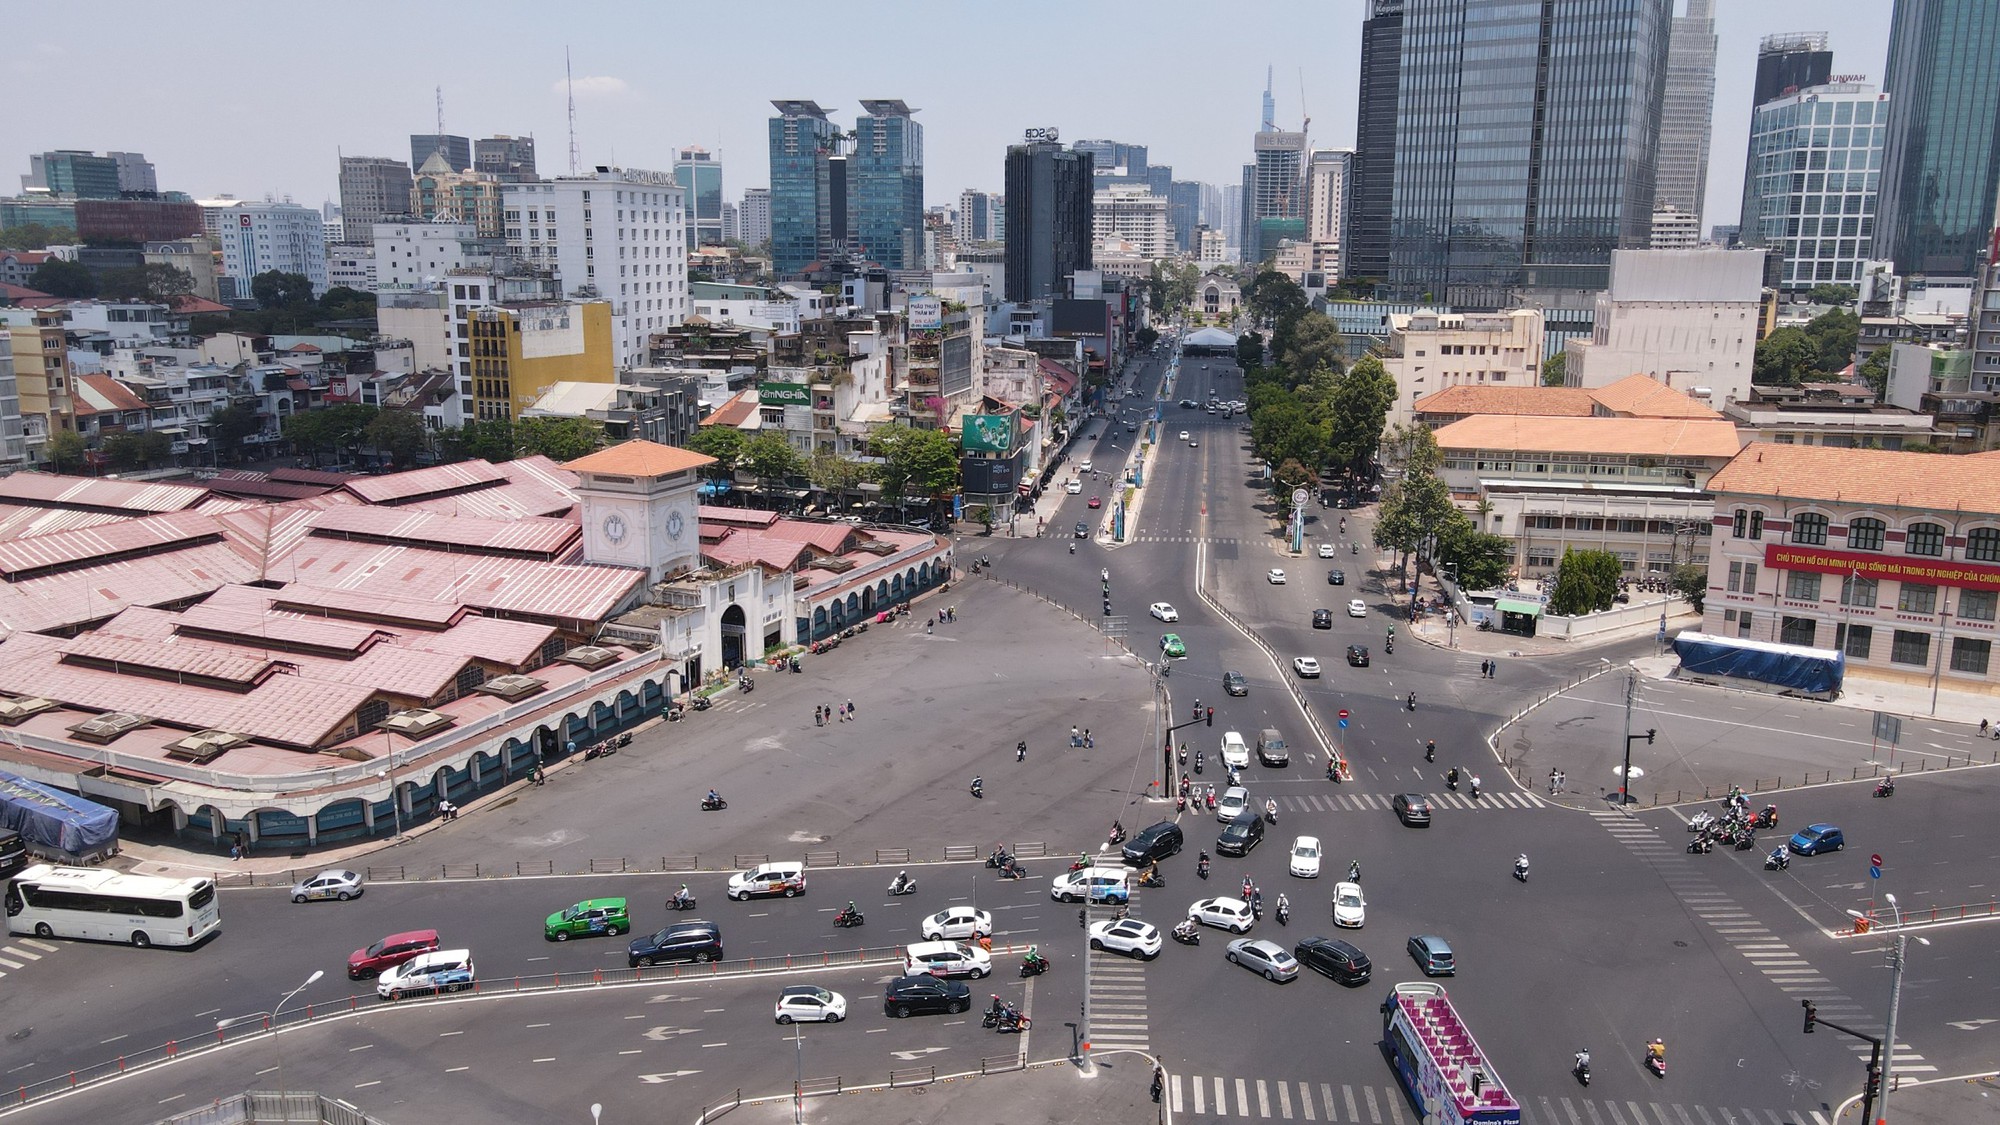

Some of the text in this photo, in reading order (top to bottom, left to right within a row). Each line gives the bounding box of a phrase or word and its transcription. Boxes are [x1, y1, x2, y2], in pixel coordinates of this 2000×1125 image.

[1376, 4, 1403, 12] Keppel
[1264, 137, 1298, 145] THE NEXUS
[1776, 552, 1790, 562] CHỦ
[1791, 554, 1806, 565] TỊCH
[1806, 554, 1816, 565] HỒ
[1817, 556, 1828, 566] CHÍ
[1829, 559, 1847, 568] MINH
[1848, 559, 1855, 569] VĨ
[1856, 561, 1867, 572] ĐẠI
[1868, 561, 1887, 572] SỐNG
[1888, 564, 1901, 574] MÃI
[1902, 566, 1925, 576] TRONG
[1926, 568, 1936, 579] SỰ
[1936, 569, 1963, 581] NGHIỆP
[1963, 570, 1978, 581] CỦA
